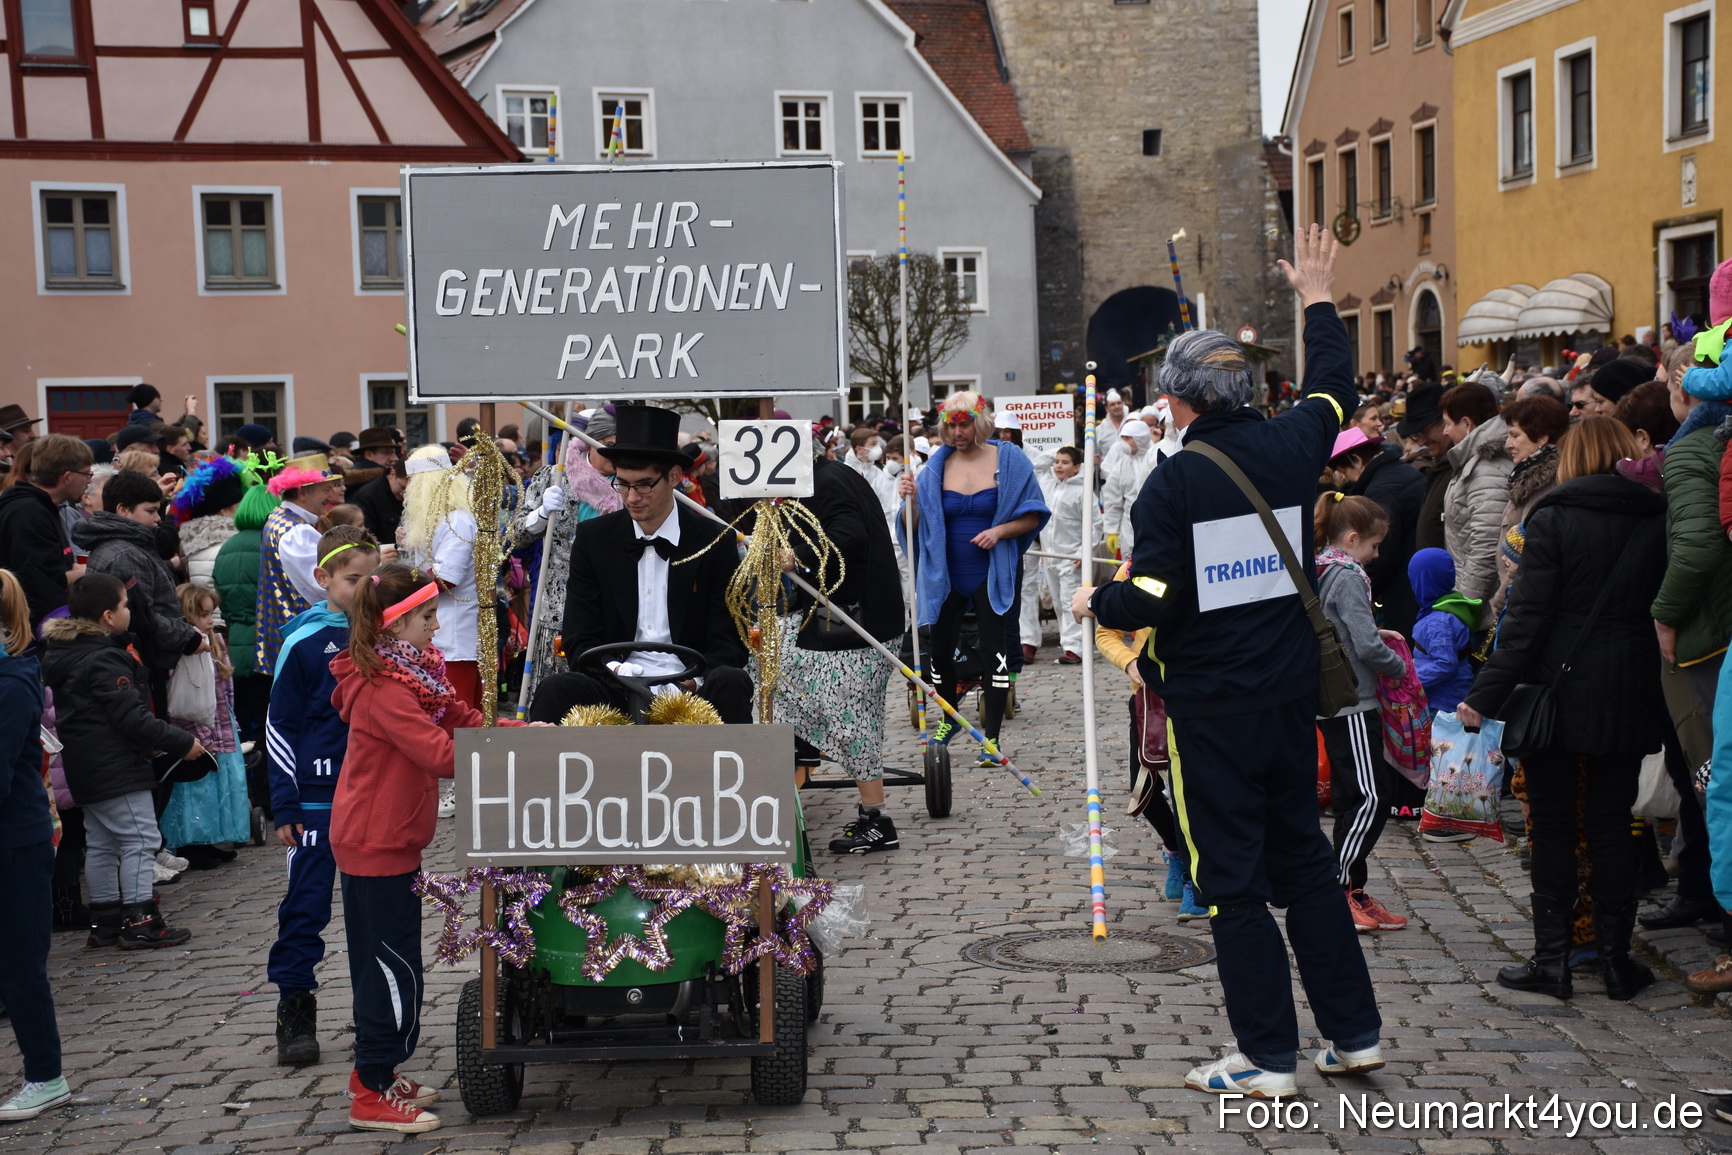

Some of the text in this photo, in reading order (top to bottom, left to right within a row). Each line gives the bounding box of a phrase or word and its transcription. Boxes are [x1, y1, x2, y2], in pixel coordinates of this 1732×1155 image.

[543, 201, 733, 250] MEHR-
[557, 332, 704, 380] PARK
[1005, 401, 1063, 411] GRAFFITI
[1016, 411, 1074, 420] NIGUNGS
[1019, 422, 1056, 431] RUPP
[729, 425, 801, 486] 32
[313, 758, 332, 776] 11
